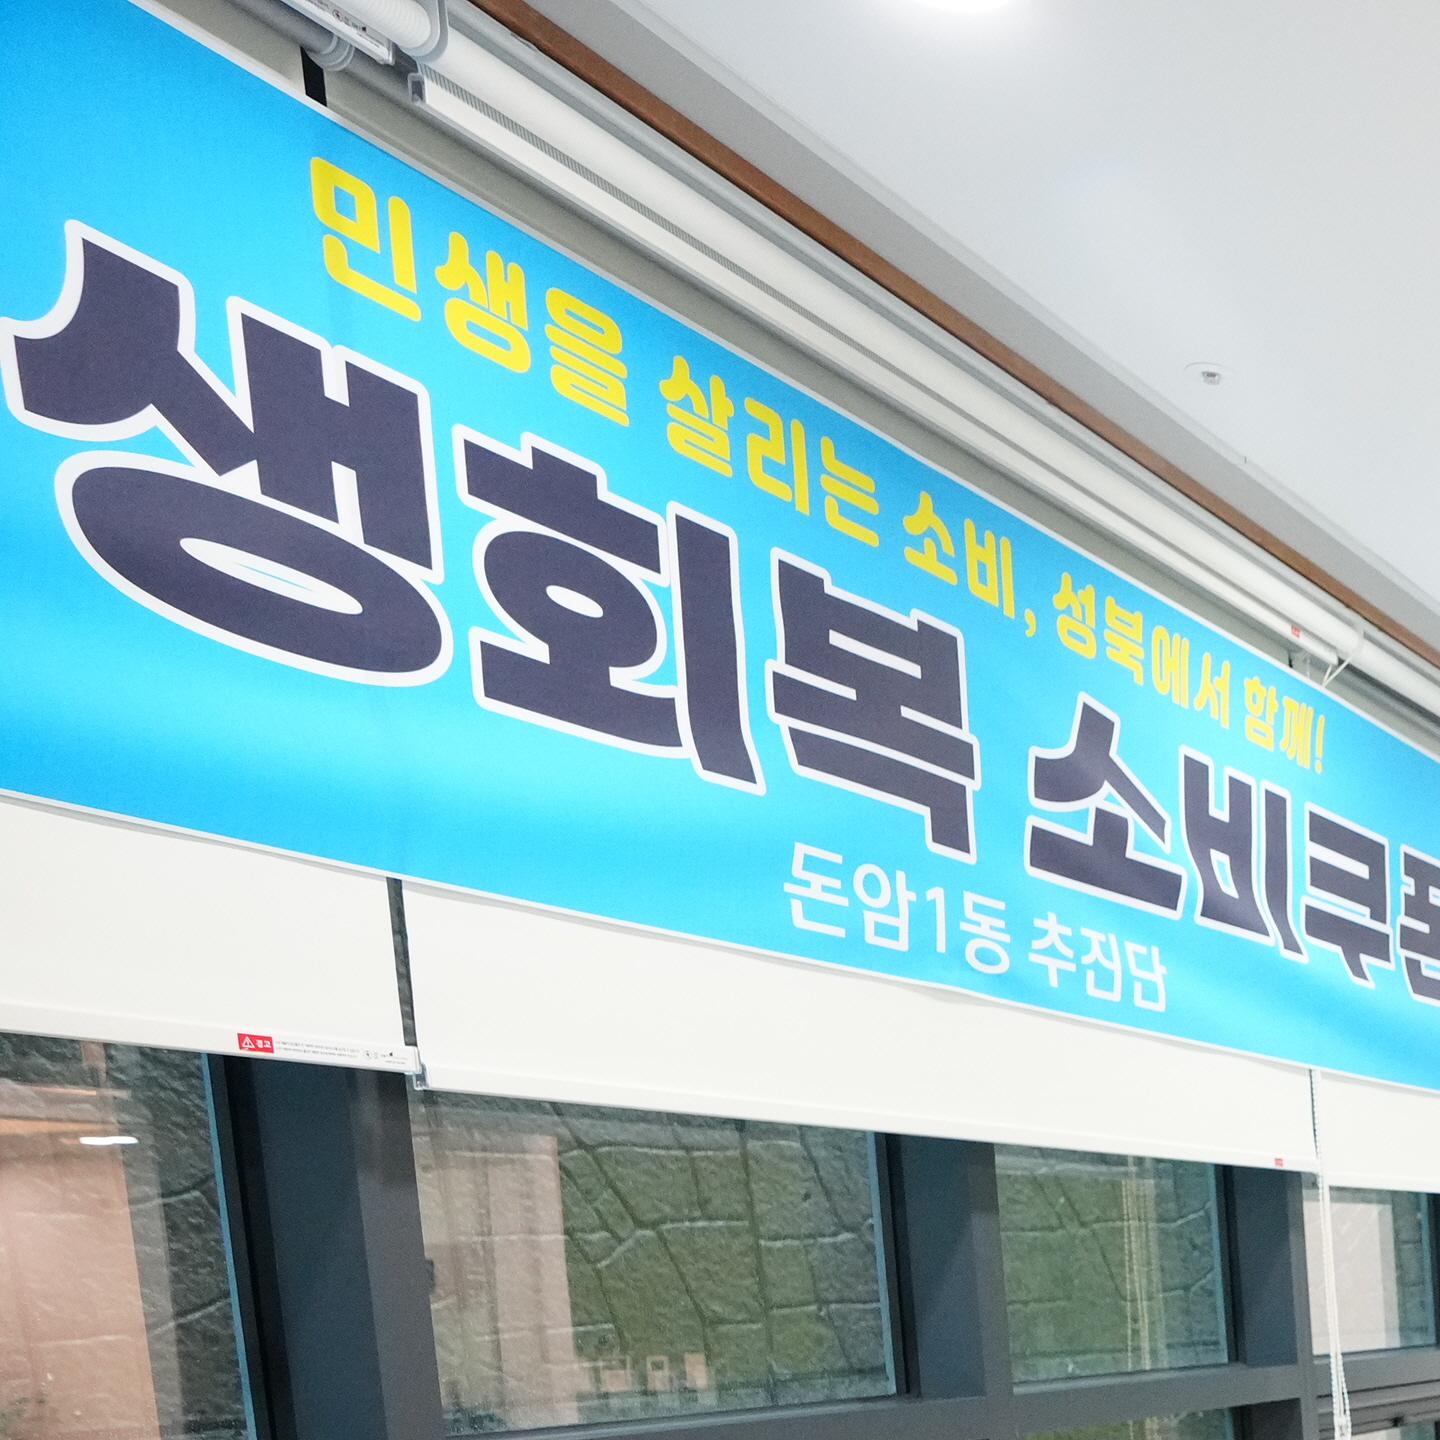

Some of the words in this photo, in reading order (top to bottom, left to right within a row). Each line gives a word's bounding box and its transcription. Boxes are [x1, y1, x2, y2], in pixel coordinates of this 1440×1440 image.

[2, 222, 981, 862] 생회복
[310, 156, 630, 427] 민생을
[658, 354, 880, 547] 살리는
[902, 489, 1038, 637] 소비,
[1051, 572, 1231, 730] 성북에서
[1244, 675, 1326, 772] 함께!
[255, 1039, 272, 1049] 경고
[783, 841, 1013, 975] 돈암1동
[1027, 909, 1170, 1013] 추진단
